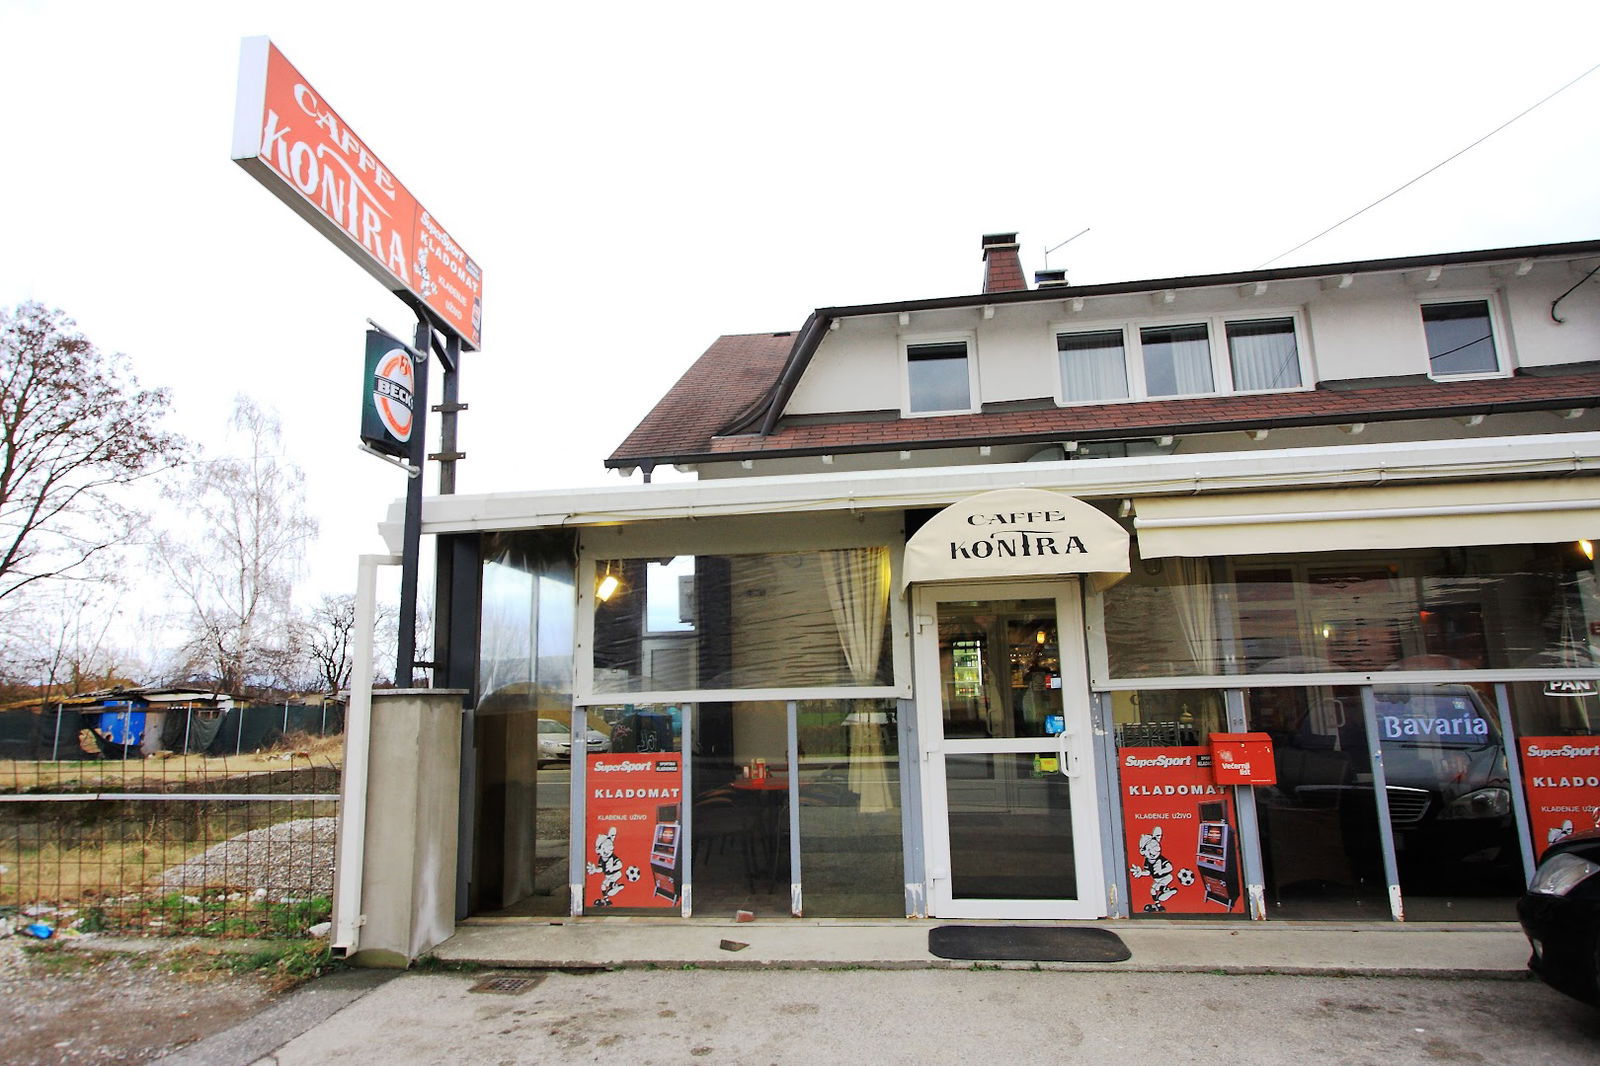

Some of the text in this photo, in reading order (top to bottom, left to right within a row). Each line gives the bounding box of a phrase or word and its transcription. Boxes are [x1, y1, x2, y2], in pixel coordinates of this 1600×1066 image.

[294, 84, 396, 200] CAFFE
[261, 109, 412, 288] KONTRA
[420, 230, 478, 292] KLADOMAT
[967, 510, 1065, 526] CAFFE
[951, 530, 1088, 559] KONTRA
[1550, 681, 1590, 690] PAN
[1384, 713, 1488, 738] Bavaria
[1527, 745, 1600, 758] SuperSport
[594, 761, 652, 773] SuperSport
[1125, 755, 1192, 768] SuperSport
[595, 788, 680, 798] KLADOMAT
[1129, 785, 1226, 795] KLADOMAT
